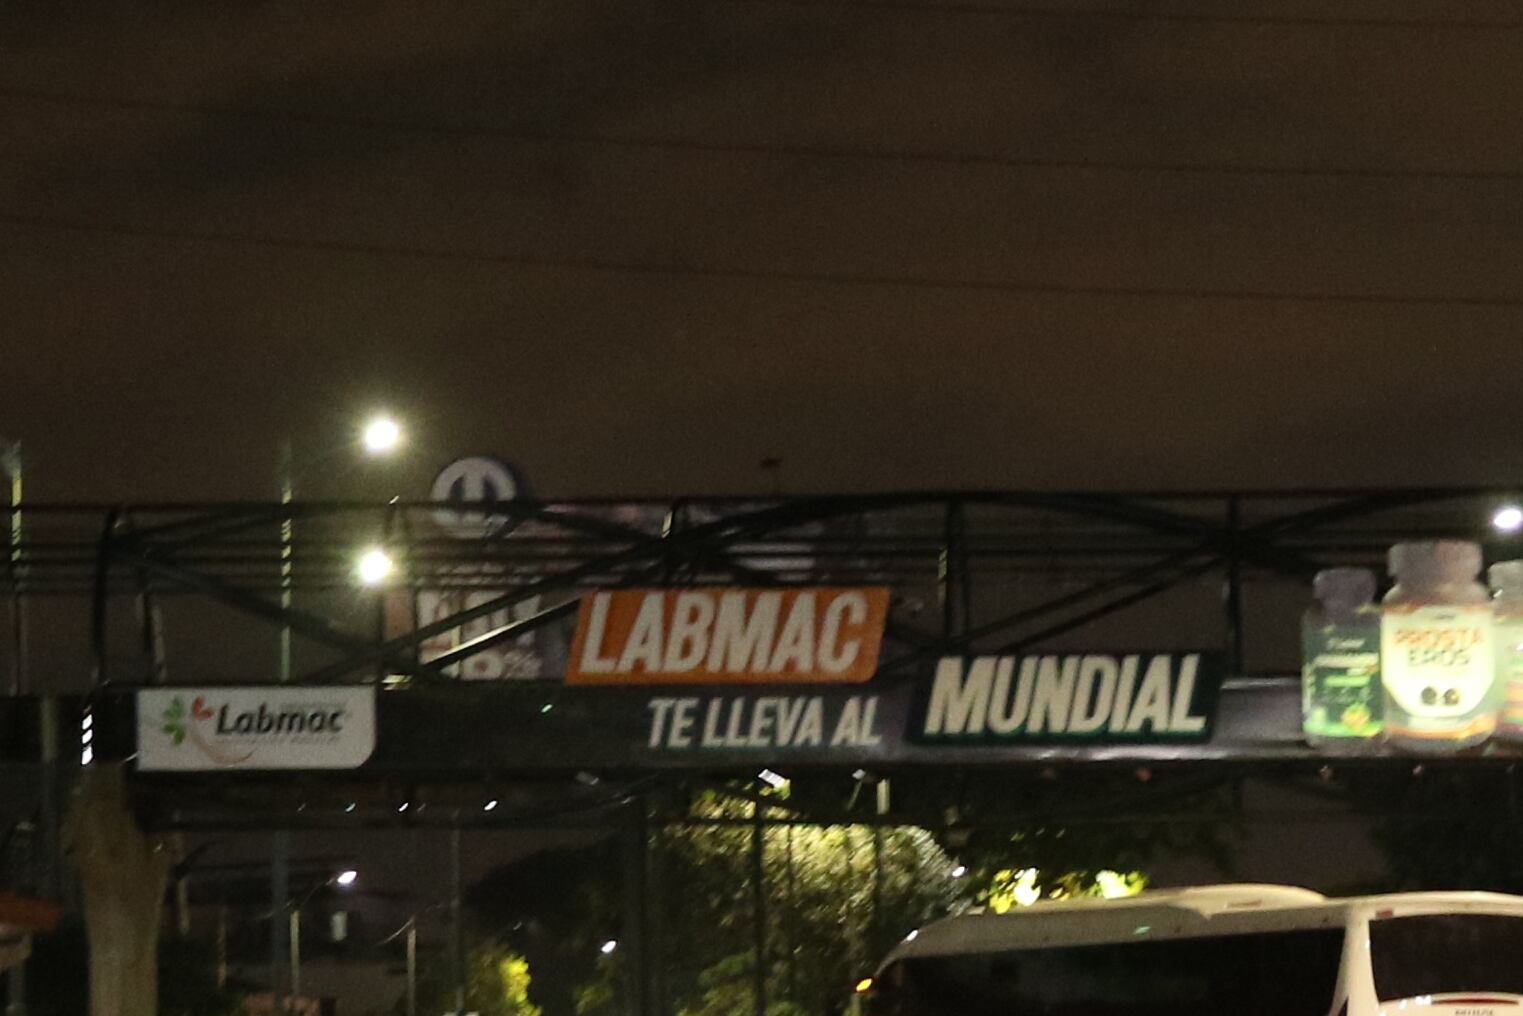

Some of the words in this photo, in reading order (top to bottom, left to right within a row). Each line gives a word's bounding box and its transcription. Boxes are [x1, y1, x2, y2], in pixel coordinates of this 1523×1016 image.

[578, 592, 867, 675] LABMAC
[215, 702, 344, 735] Labmac
[647, 698, 699, 747] TE
[702, 698, 822, 748] LLEVA
[829, 696, 883, 745] AL
[924, 654, 1207, 737] MUNDIAL
